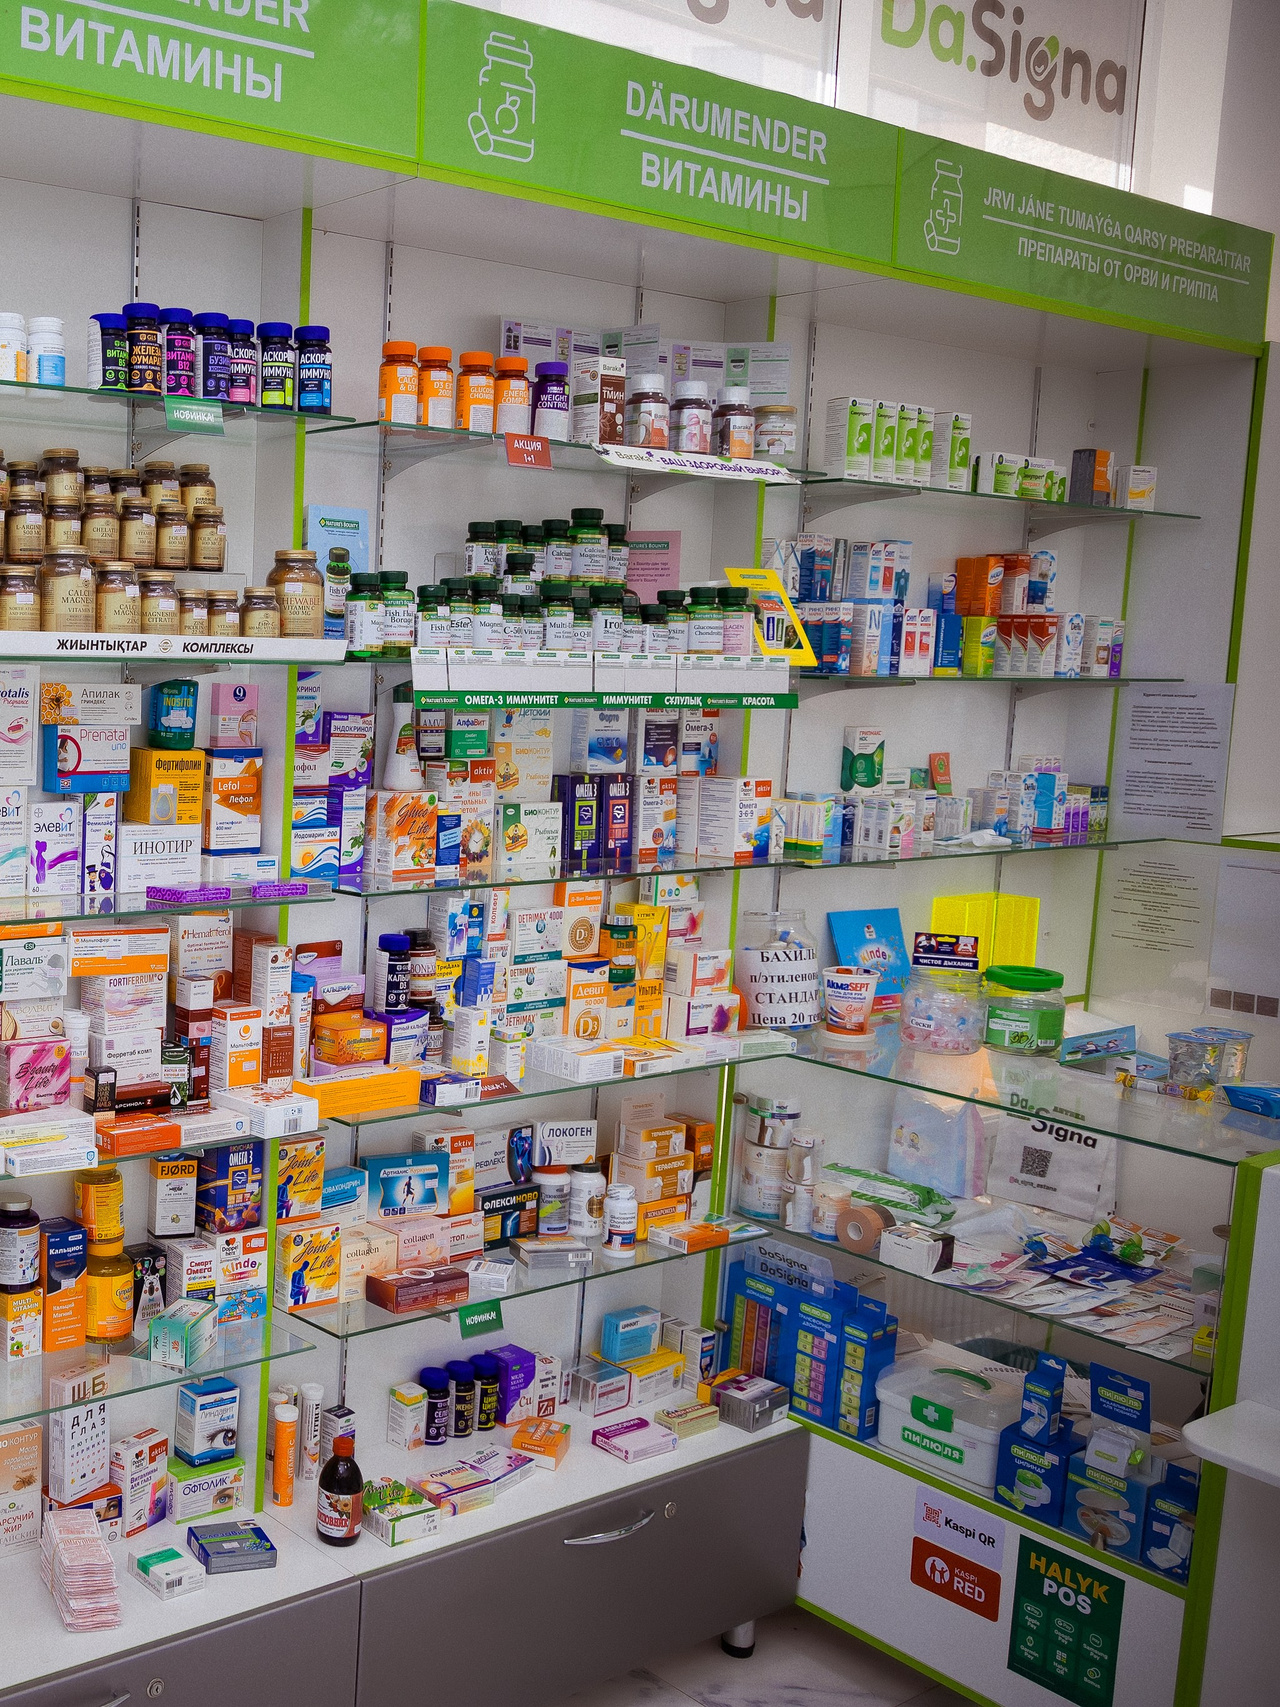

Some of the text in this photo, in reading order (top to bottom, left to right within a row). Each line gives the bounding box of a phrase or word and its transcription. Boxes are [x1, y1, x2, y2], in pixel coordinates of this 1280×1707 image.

[21, 6, 282, 103] ВИТАМИНЫ
[626, 81, 826, 164] DÄRUMENDER
[641, 152, 807, 222] ВИТАМИНЫ
[984, 187, 1014, 212] JRVI
[1018, 194, 1054, 222] JÁNE
[1125, 224, 1167, 252] QARSY
[1170, 236, 1251, 273] PREPARATTAR
[1018, 237, 1218, 302] ПРЕПАРАТЫ ОТ ОРВИ И ГРИППА
[540, 394, 567, 402] WEIGHT
[603, 389, 624, 399] ТМИН
[537, 401, 568, 410] CONTROL
[173, 409, 214, 423] НОВИНКА!
[514, 440, 542, 451] АКЦИЯ
[524, 454, 535, 464] 1+1
[615, 451, 784, 477] Baraka ВАШ ЗДОРОВЫЙ ВЫБОР!
[56, 639, 147, 653] ЖИЫНТЫҚТАР
[182, 642, 254, 654] КОМПЛЕКСЫ
[81, 688, 120, 699] Апилак
[163, 697, 193, 708] INOSITOL
[465, 695, 559, 705] ОМЕГА-3 ИММУНИТЕТ
[602, 695, 653, 705] ИММУНИТЕТ
[742, 696, 775, 706] КРАСОТА
[456, 719, 485, 727] АлфаВит
[685, 723, 713, 733] Омега-3
[80, 728, 127, 742] Prenatal
[156, 758, 202, 772] Фертифолин
[218, 781, 240, 791] Lefol
[228, 795, 253, 804] Лефол
[739, 810, 754, 818] 3-6-9
[294, 831, 326, 839] Йодомарин
[132, 840, 193, 855] ИНОТИР
[490, 893, 499, 925] КОЛЕФЕР
[518, 910, 563, 923] DETRIMAX 4000
[4, 953, 44, 966] Лаваль
[919, 958, 973, 968] ЧИСТОЕ ДЫХАНИЕ
[510, 967, 536, 977] DETRIMAX
[109, 974, 154, 987] FORTIFERRUM
[576, 986, 605, 997] Девит
[752, 1012, 804, 1026] Цена 20
[911, 1019, 934, 1029] Соски
[106, 1049, 134, 1058] Ферретаб
[548, 1126, 592, 1138] ЛОКОГЕН
[453, 1140, 472, 1148] aktiv
[475, 1156, 505, 1169] РЕФЛЕКС
[655, 1161, 684, 1172] ТЕРАФЛЕКС
[161, 1164, 195, 1177] FJØRD
[484, 1191, 539, 1209] ФЛЕКСИНОВО
[403, 1232, 435, 1245] collagen
[50, 1244, 83, 1255] Кальциос
[347, 1247, 379, 1259] collagen
[186, 1267, 212, 1275] Омега
[760, 1262, 808, 1289] DaSigna
[12, 1302, 38, 1312] VITAMIN
[466, 1312, 496, 1325] НОВИНКА!
[622, 1321, 640, 1330] ЦИНКИТ
[520, 1396, 532, 1407] Cu
[538, 1402, 554, 1416] Zn
[600, 1418, 640, 1434] САМБОВИН
[522, 1443, 544, 1452] ТРИОВИТ
[183, 1478, 227, 1496] ОФТОЛИК
[4, 1524, 22, 1534] ЖИР
[944, 1516, 996, 1548] Kaspi QR
[955, 1567, 978, 1583] KASPI
[1029, 1552, 1109, 1604] HALYK
[953, 1577, 985, 1603] RED
[1043, 1578, 1092, 1615] POS
[1025, 1616, 1040, 1626] Apple
[1054, 1629, 1073, 1642] Google
[1082, 1643, 1108, 1660] Samsung
[1083, 1677, 1101, 1688] Bonus
